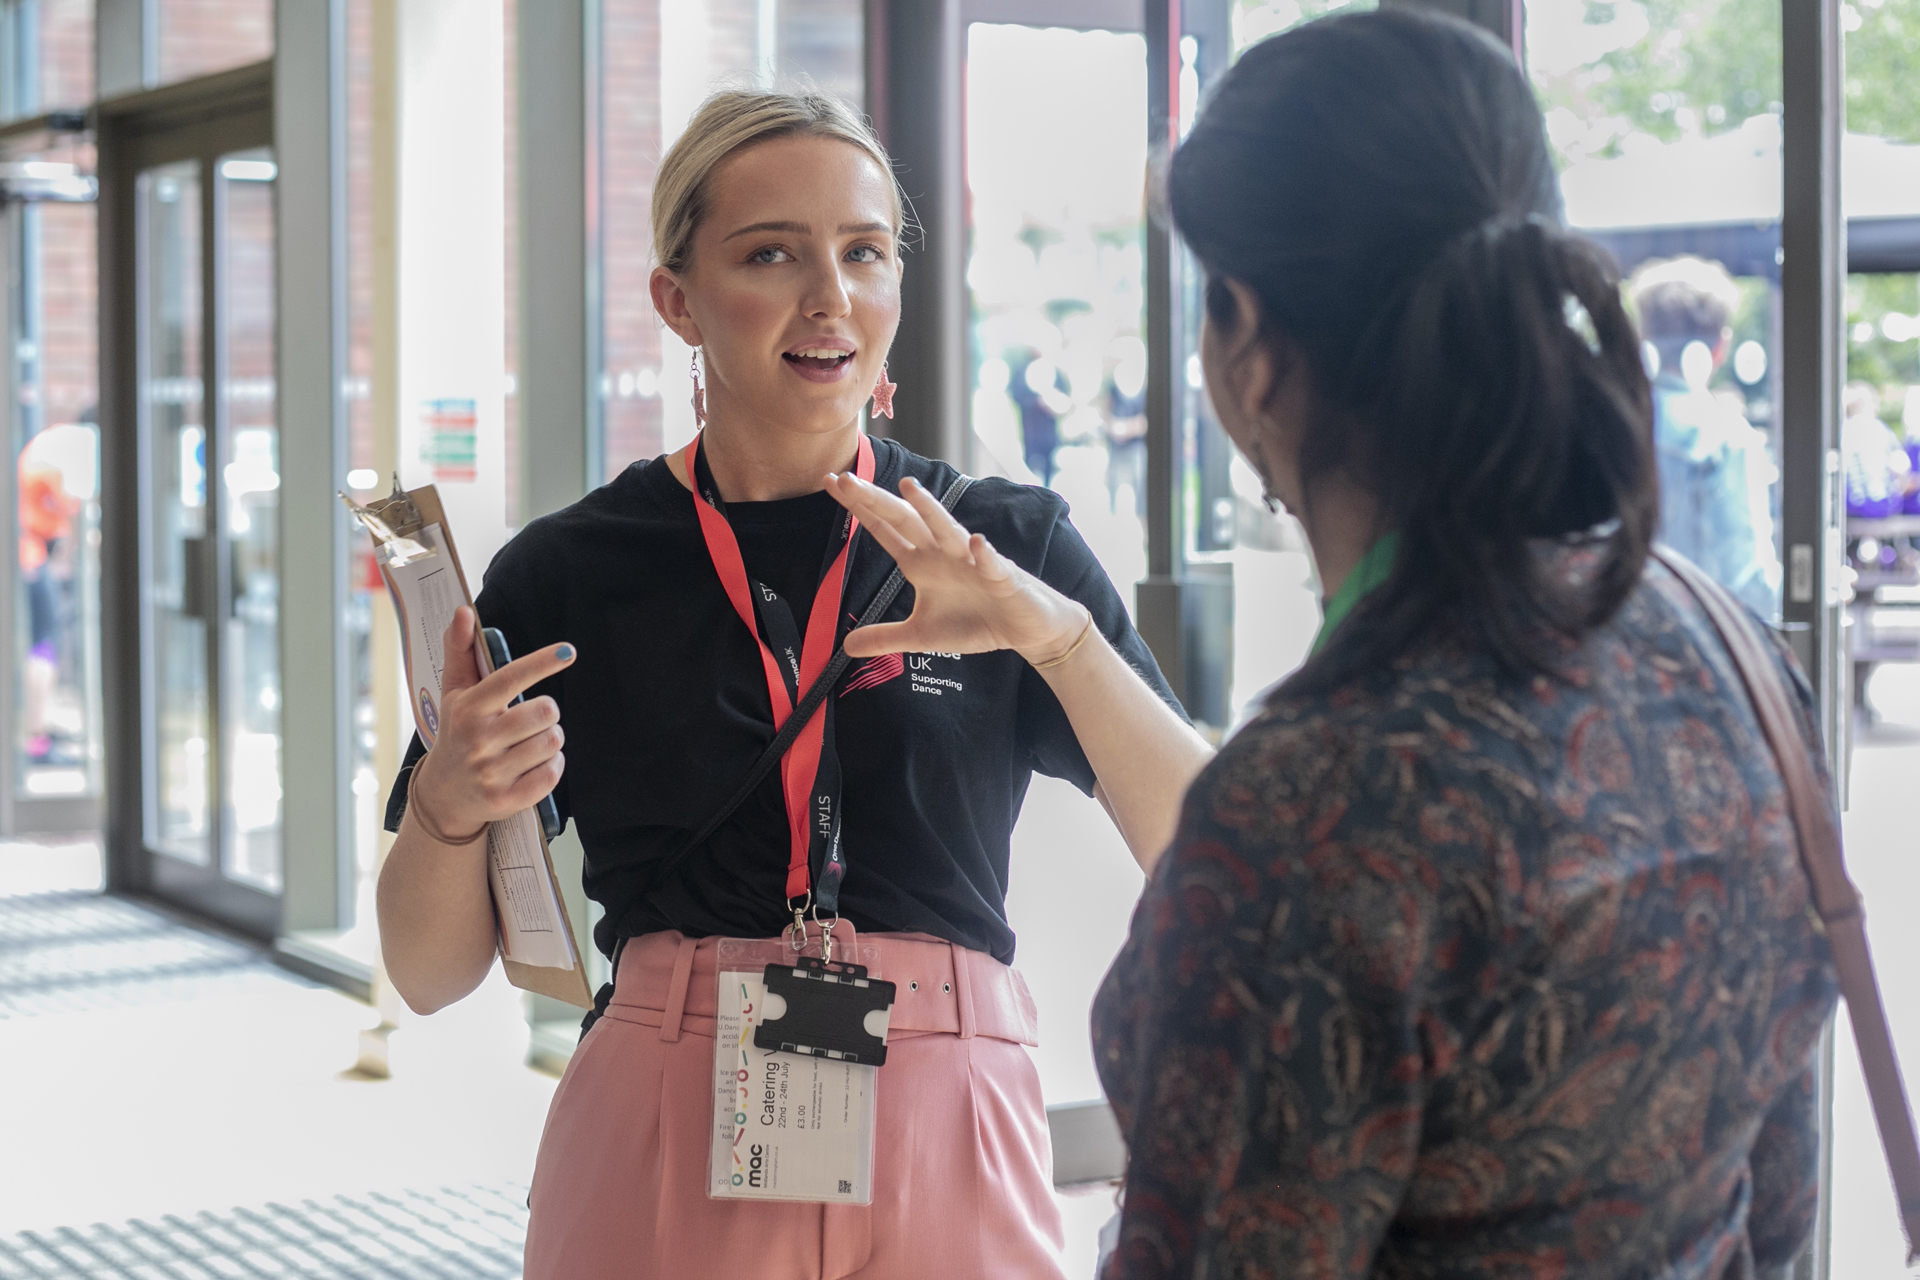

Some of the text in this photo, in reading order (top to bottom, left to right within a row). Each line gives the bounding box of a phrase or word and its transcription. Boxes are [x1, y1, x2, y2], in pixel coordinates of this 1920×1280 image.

[909, 656, 933, 671] UK
[911, 673, 963, 692] Supporting
[912, 683, 942, 696] Dance
[818, 795, 831, 839] STAFF
[780, 1061, 790, 1078] July
[760, 1062, 780, 1126] Catering
[779, 1079, 788, 1099] 24th
[778, 1106, 787, 1128] 22nd
[797, 1105, 806, 1129] £3.00
[748, 1144, 763, 1188] mac
